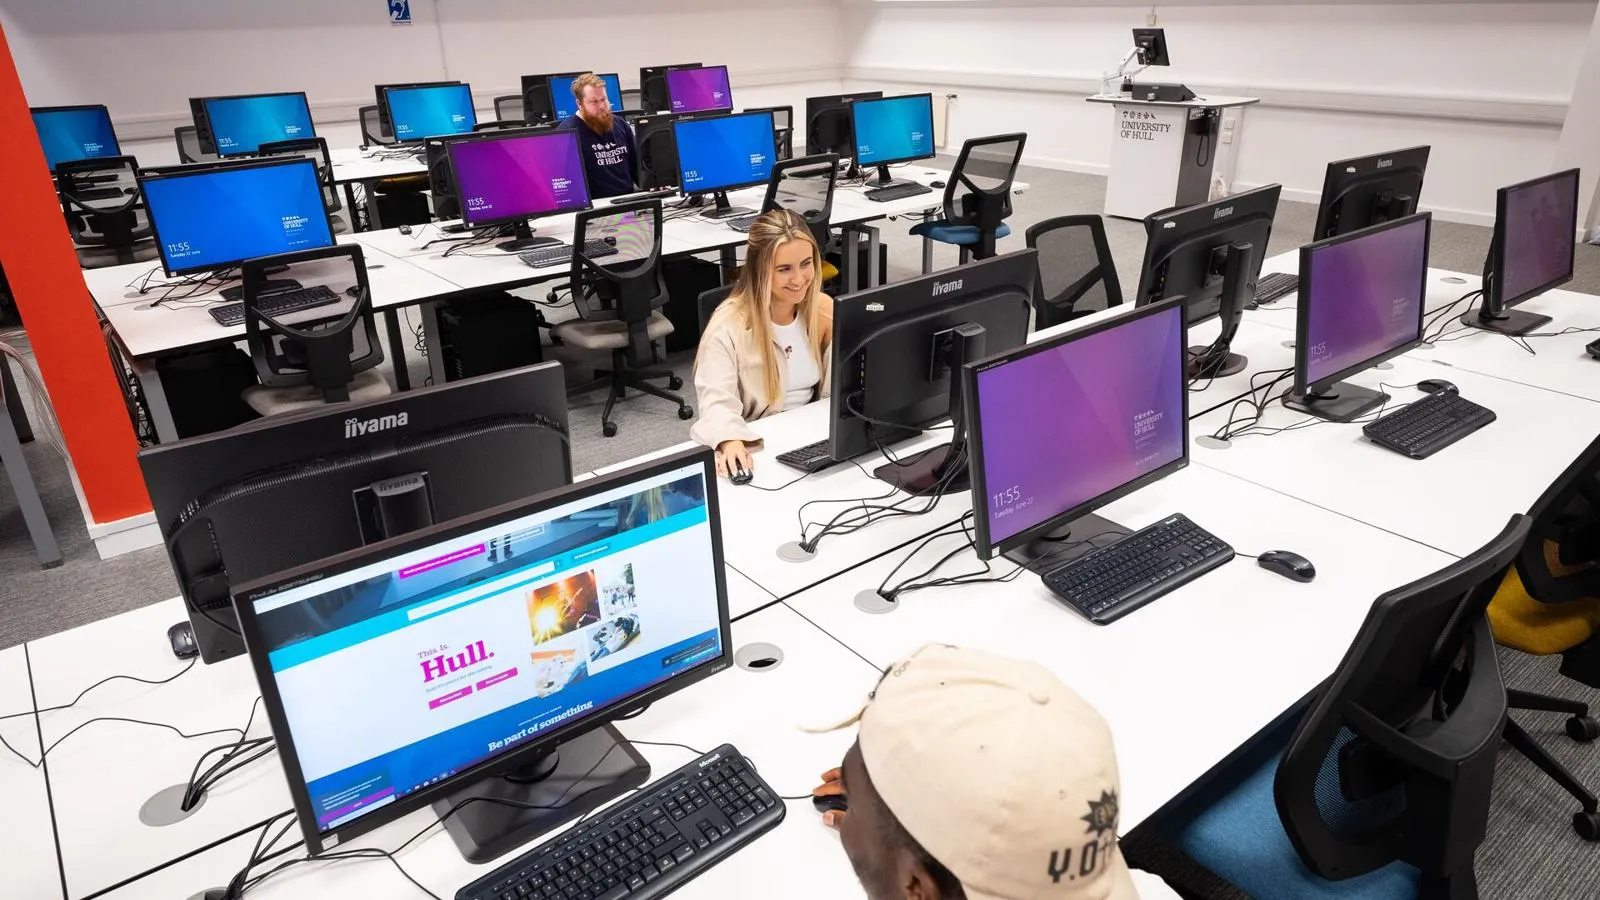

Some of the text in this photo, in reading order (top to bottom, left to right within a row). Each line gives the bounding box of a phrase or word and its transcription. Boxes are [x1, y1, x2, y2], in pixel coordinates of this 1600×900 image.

[1121, 121, 1171, 133] UNIVERSITY
[1120, 130, 1154, 141] OF HULL
[605, 155, 623, 165] HULL
[468, 197, 484, 206] 11:55
[168, 241, 190, 252] 11:55
[932, 279, 963, 297] iiyama
[345, 411, 409, 439] iiyama
[1134, 412, 1163, 430] UNIVERSITY
[1141, 422, 1154, 434] HULL
[992, 485, 1020, 509] 11:55
[418, 648, 438, 658] This
[420, 640, 495, 683] Hull.
[487, 740, 504, 752] Be
[503, 728, 527, 746] part
[527, 722, 539, 734] of
[539, 700, 594, 730] something
